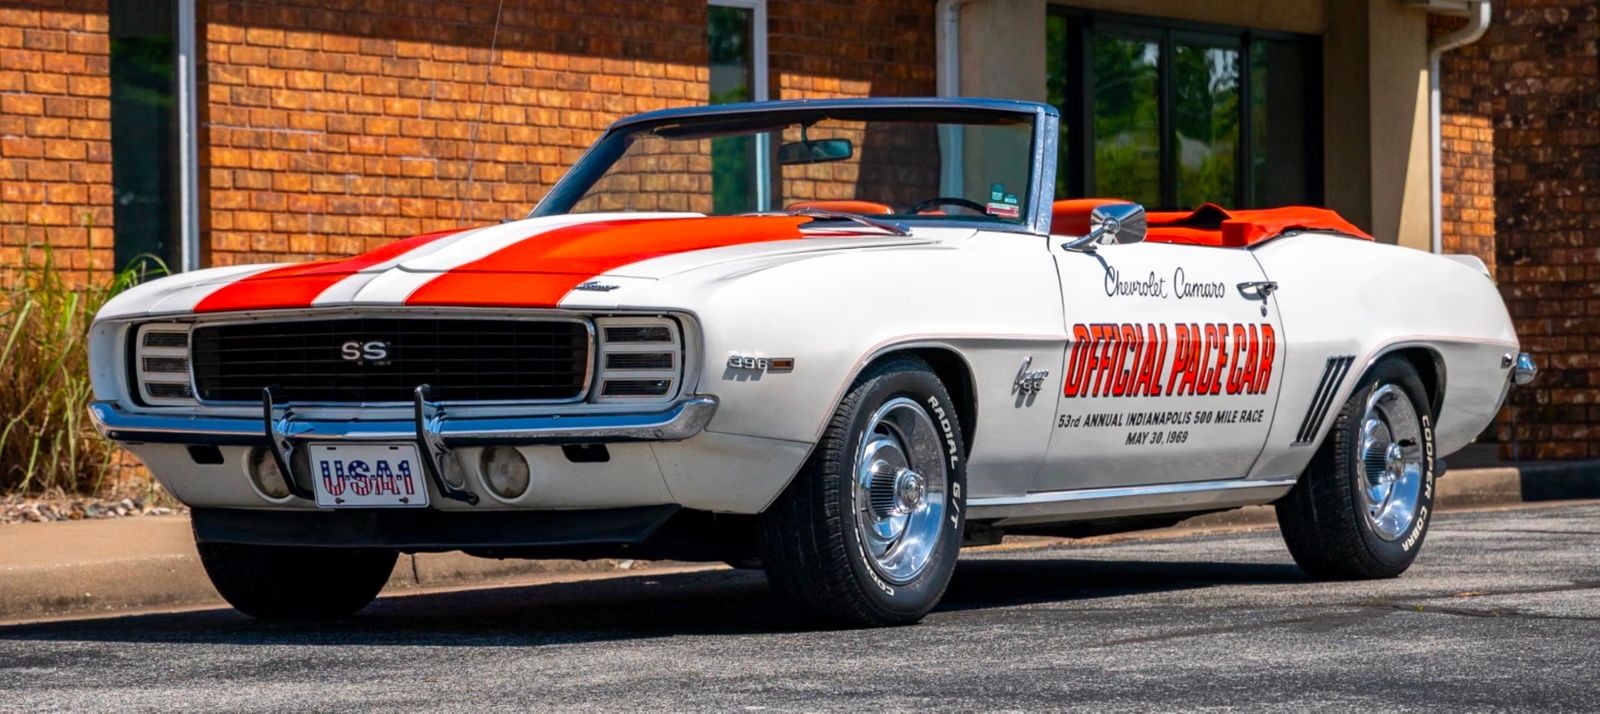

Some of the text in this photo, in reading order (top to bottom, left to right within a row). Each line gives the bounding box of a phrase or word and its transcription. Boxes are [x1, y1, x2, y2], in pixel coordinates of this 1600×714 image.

[1104, 265, 1225, 299] Chevrolet Camaro
[341, 341, 387, 360] SS
[727, 355, 768, 370] 396
[1063, 323, 1275, 397] OFFICIAL PACE CAR
[1058, 409, 1264, 428] 53rd ANNUAL INDIANAPOLIS 500 MILE RACE
[1125, 432, 1149, 445] MAY
[927, 396, 961, 529] RADIAL G/T
[1401, 415, 1434, 553] COOPER COBRA
